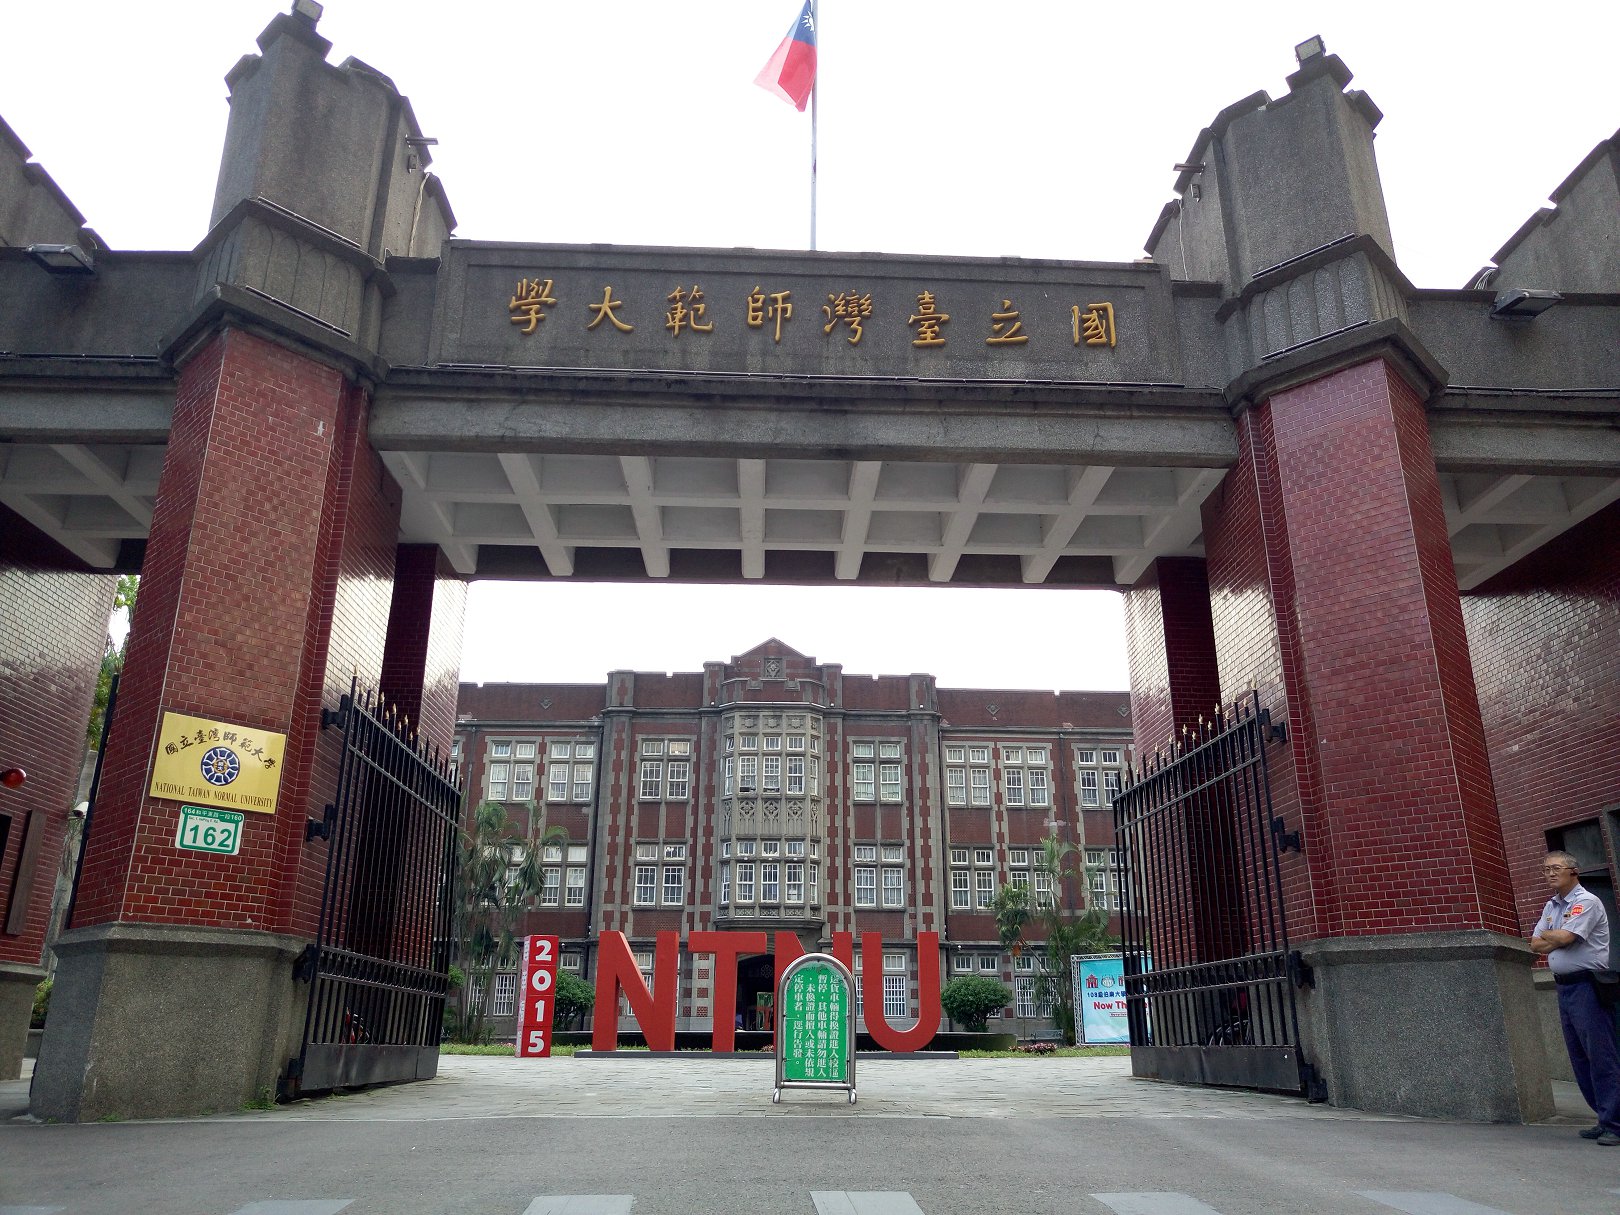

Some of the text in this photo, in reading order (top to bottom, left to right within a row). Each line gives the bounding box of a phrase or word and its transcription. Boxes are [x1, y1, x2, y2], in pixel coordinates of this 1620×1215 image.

[165, 728, 276, 769] 國立臺灣師範大學
[154, 782, 274, 808] NATIONAL TAIWAN NORMAL UNIVERSITY
[189, 824, 232, 848] 162
[527, 939, 553, 1054] 2015
[1093, 1001, 1113, 1010] Now
